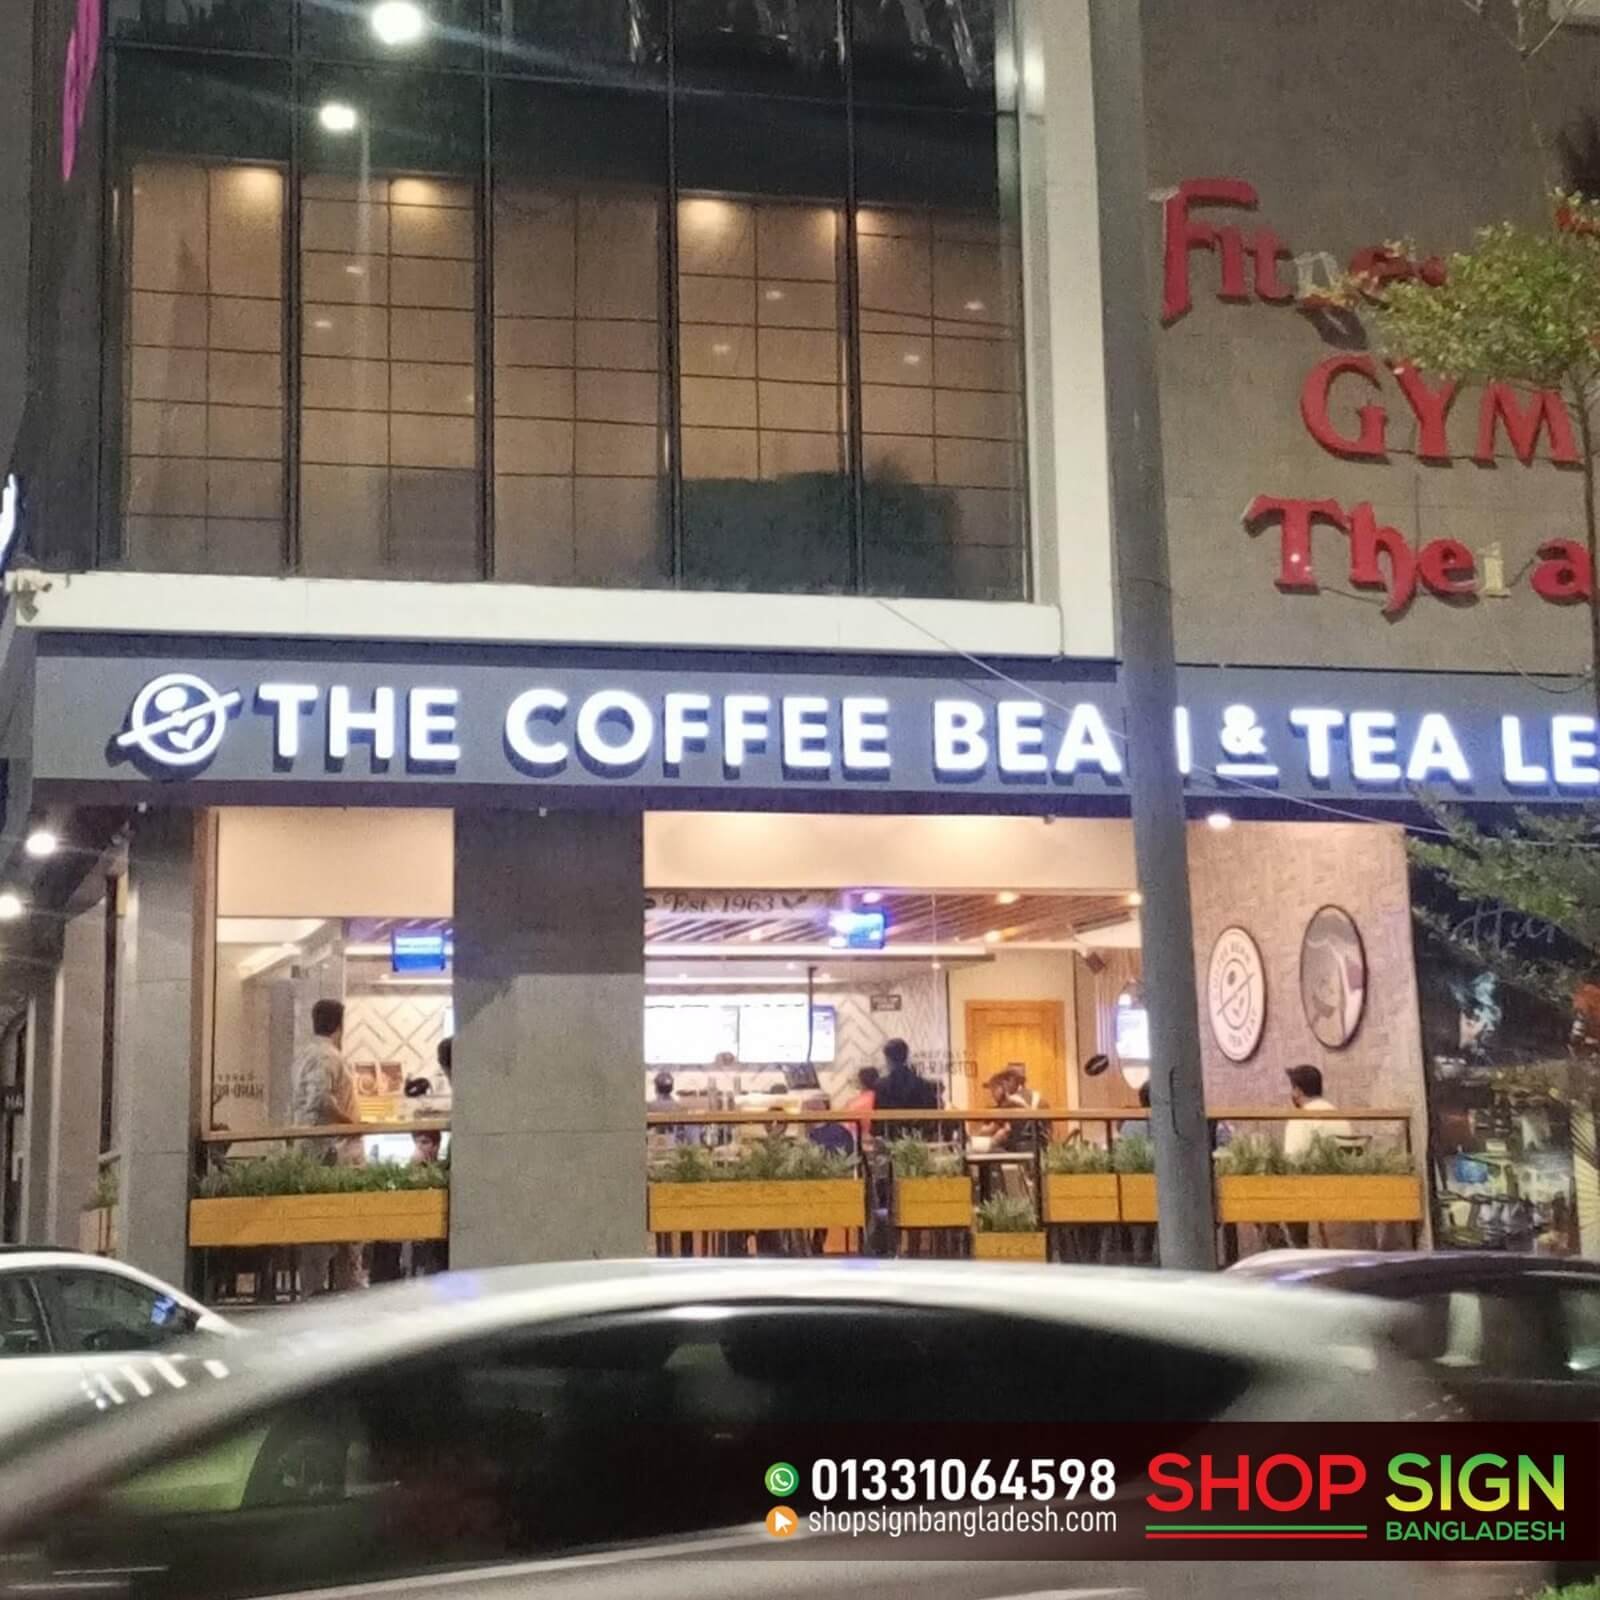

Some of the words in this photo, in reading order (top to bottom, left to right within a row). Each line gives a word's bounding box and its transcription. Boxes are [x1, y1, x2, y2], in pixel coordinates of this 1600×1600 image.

[1301, 353, 1584, 468] GYM
[258, 683, 461, 762] THE
[505, 688, 892, 770] COFFEE
[1218, 703, 1273, 760] &
[1290, 708, 1471, 782] TEA
[1502, 714, 1600, 786] LE
[720, 893, 775, 913] 1963
